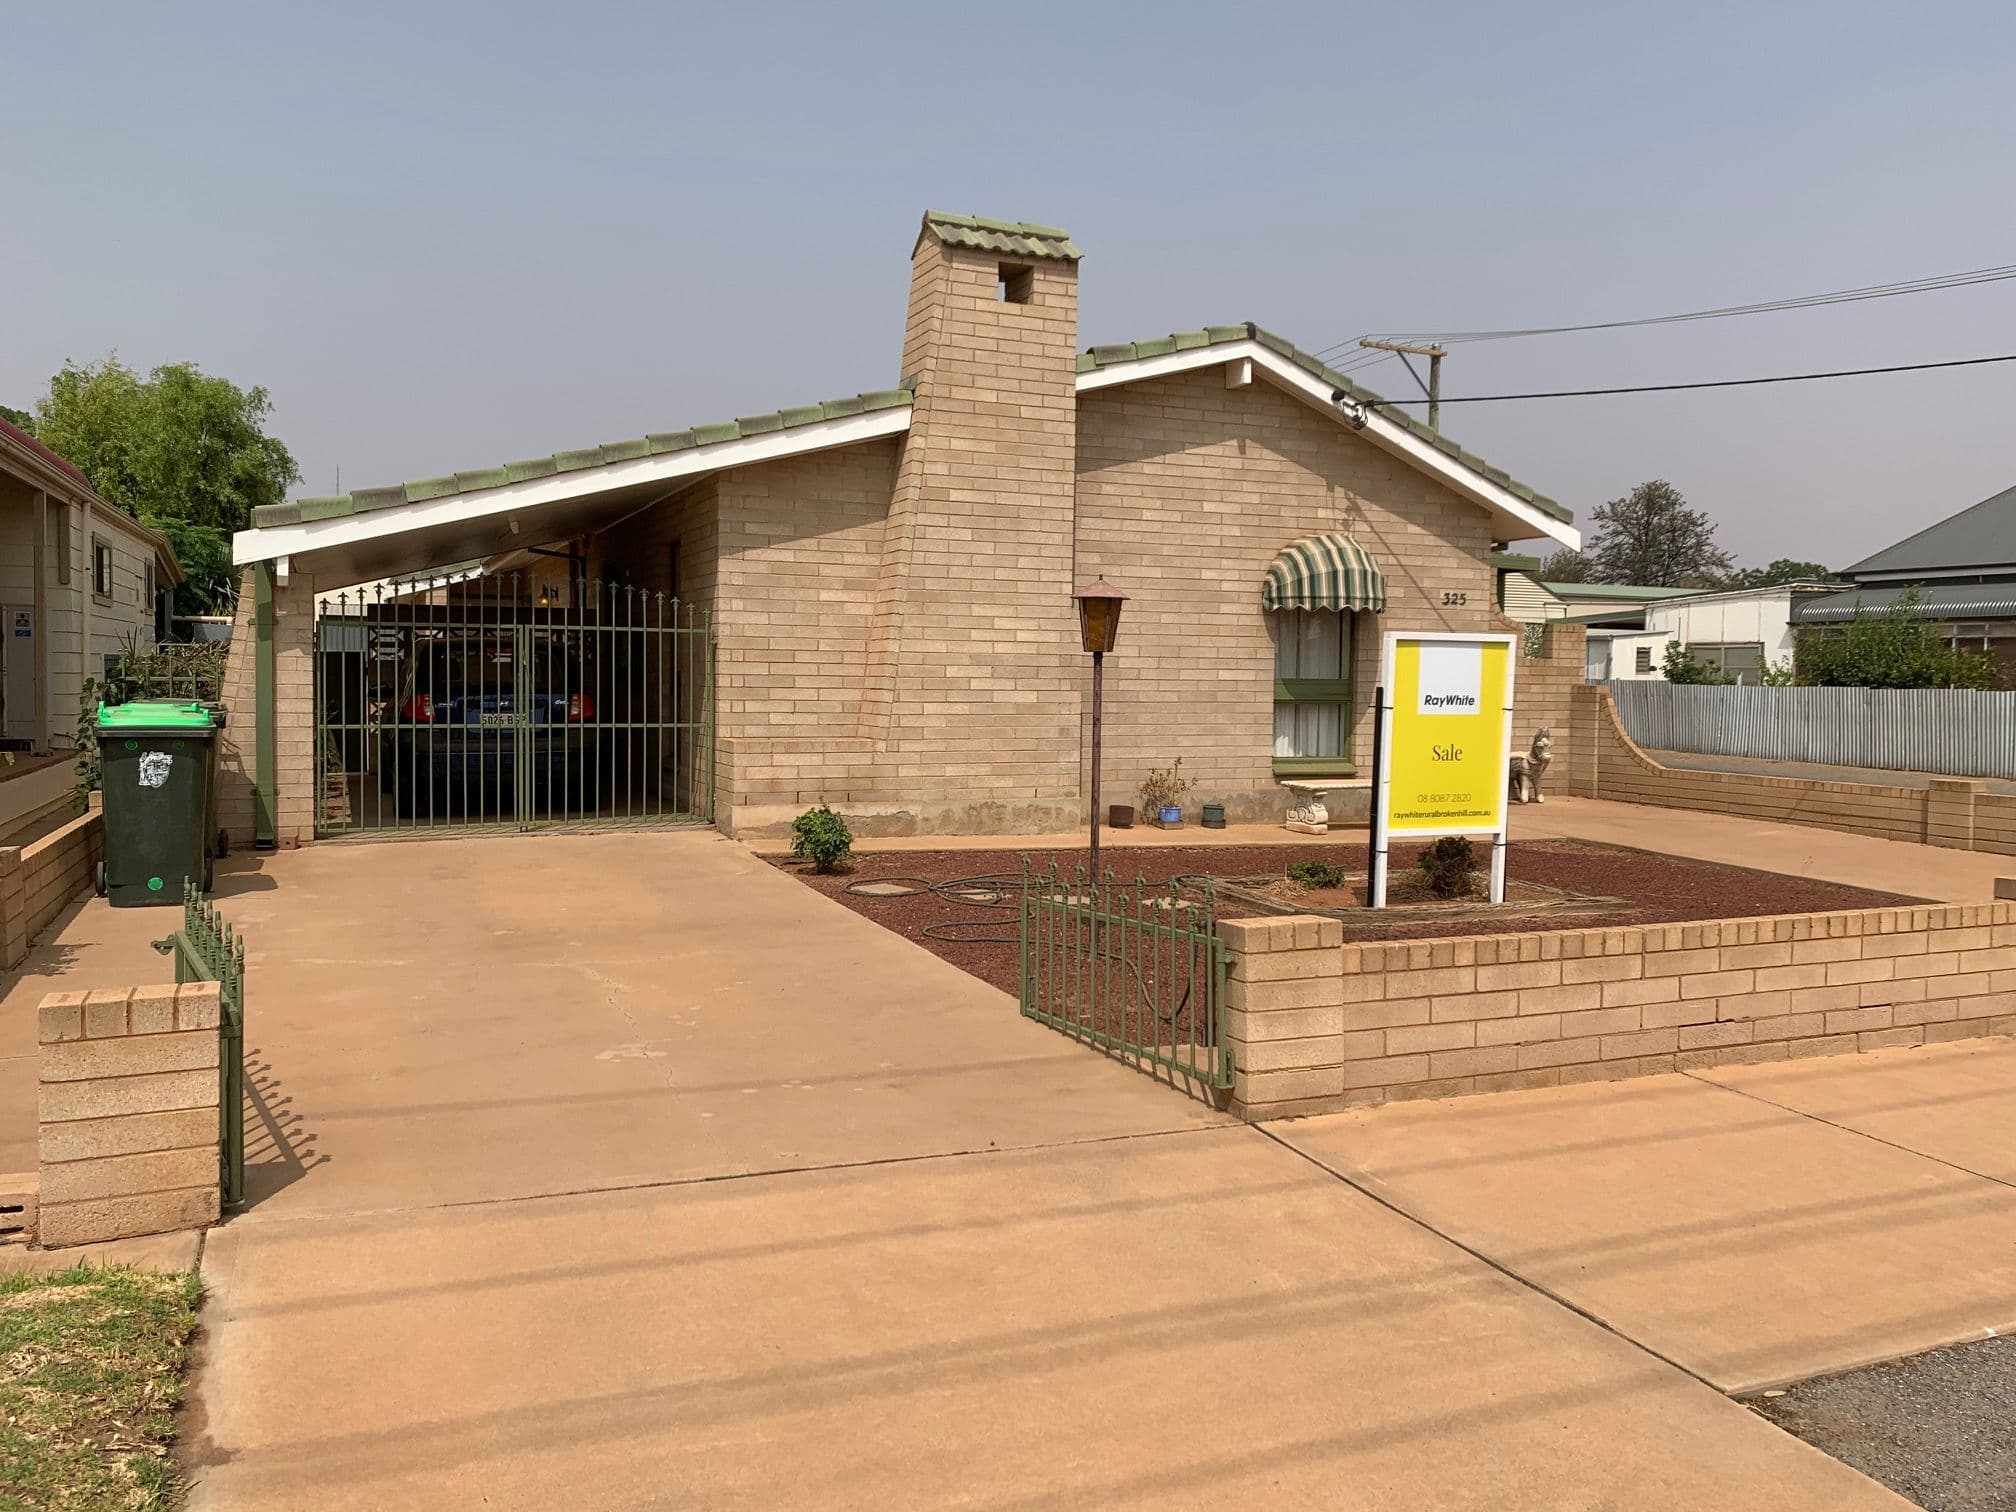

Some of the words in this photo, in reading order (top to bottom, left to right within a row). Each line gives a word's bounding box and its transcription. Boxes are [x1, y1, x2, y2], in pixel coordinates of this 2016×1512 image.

[1441, 592, 1467, 606] 325
[1424, 694, 1476, 708] RayWhite
[1431, 743, 1463, 762] Sale
[1417, 793, 1428, 804] 08
[1429, 793, 1450, 804] 8087
[1451, 793, 1472, 803] 2820
[1393, 809, 1491, 820] raywhiteruralbrokenhill.com.au
